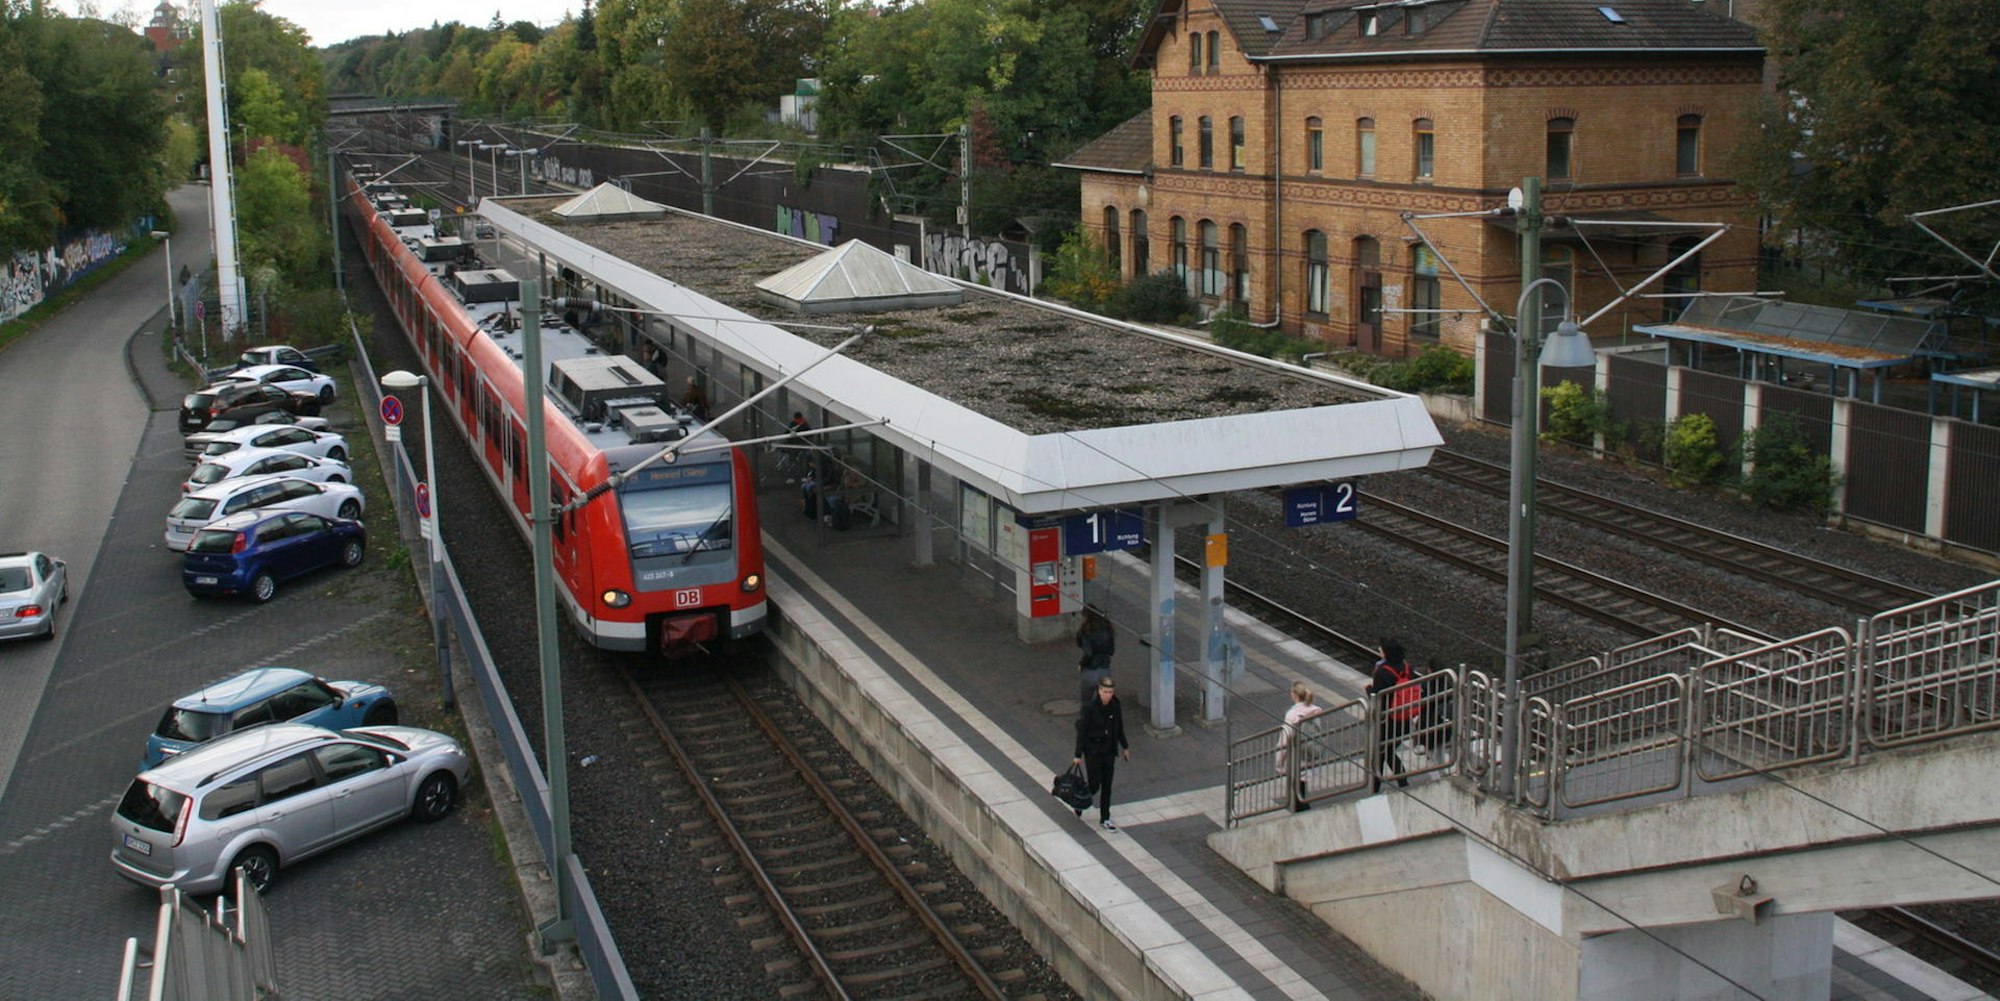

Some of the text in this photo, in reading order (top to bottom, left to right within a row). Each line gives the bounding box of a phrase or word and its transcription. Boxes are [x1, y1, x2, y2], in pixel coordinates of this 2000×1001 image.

[1336, 482, 1353, 513] 2
[1086, 512, 1098, 544] 1
[677, 591, 699, 605] DB
